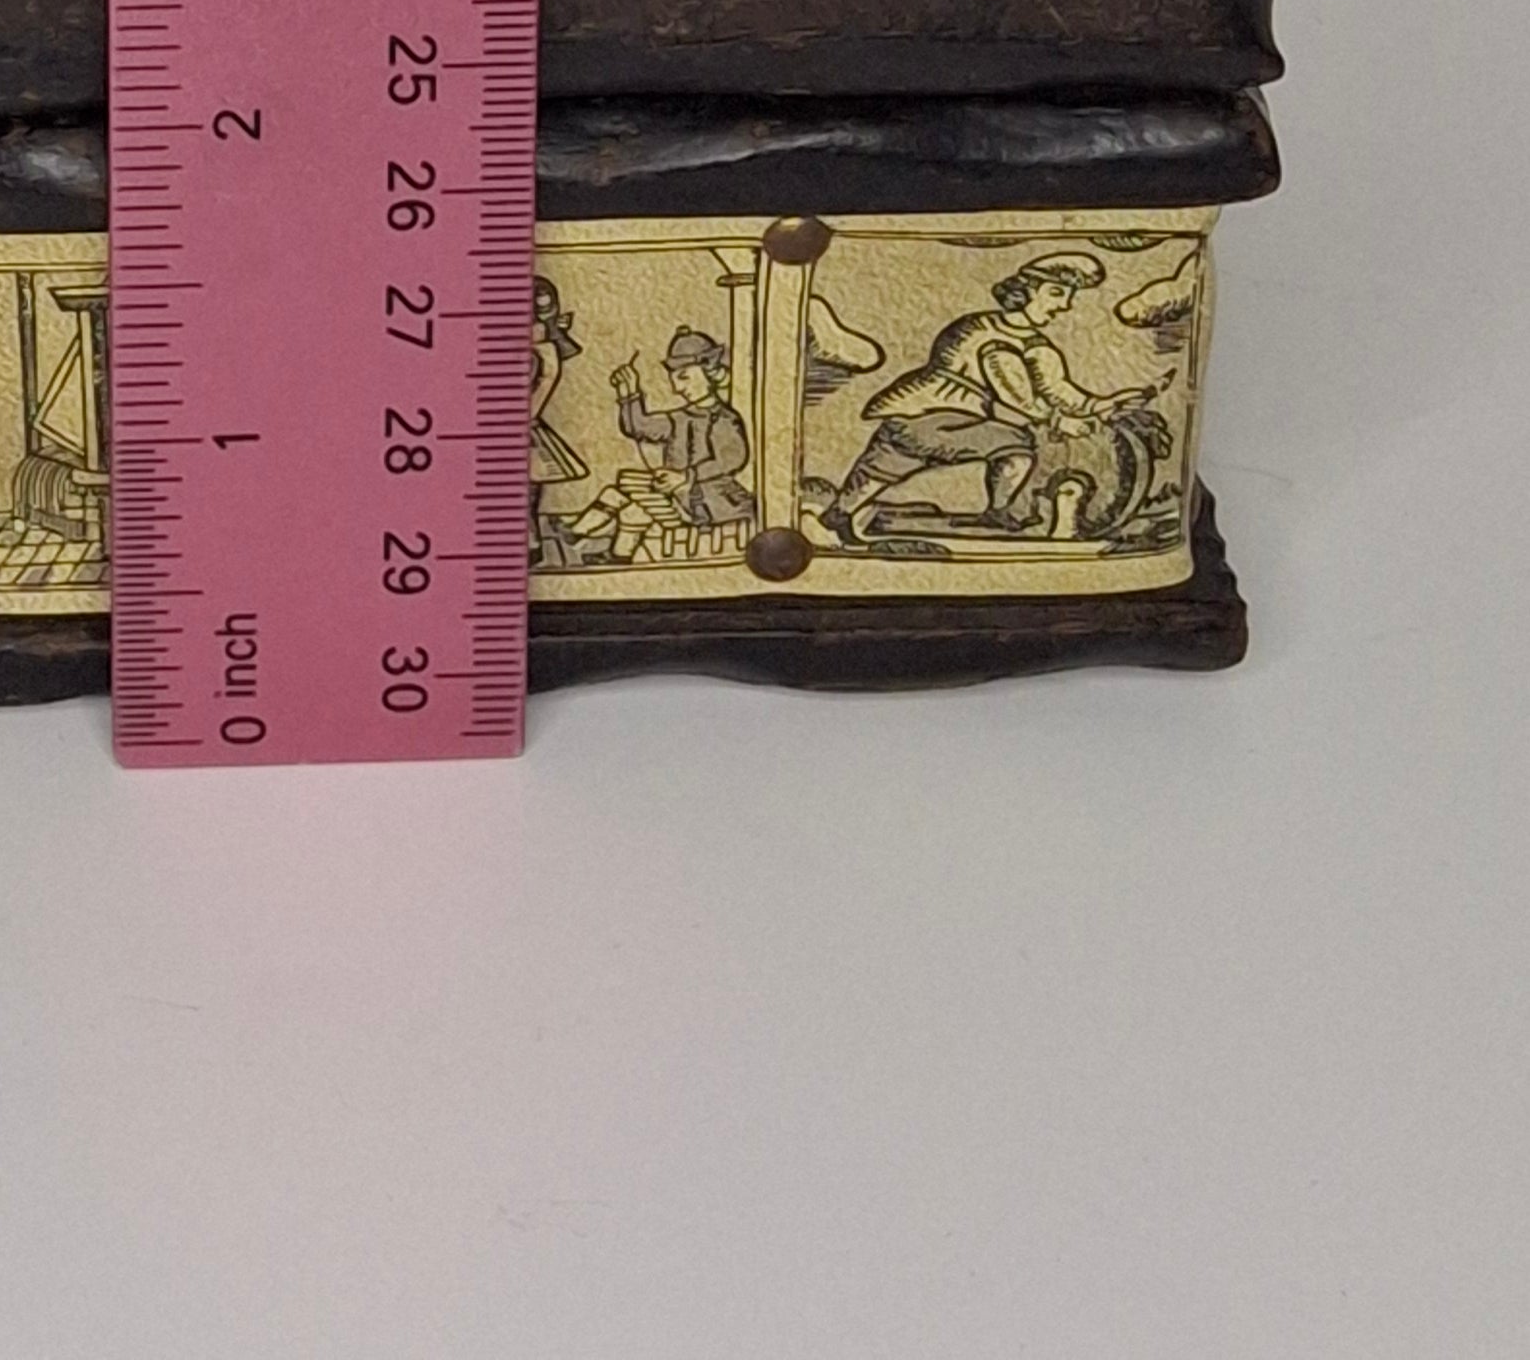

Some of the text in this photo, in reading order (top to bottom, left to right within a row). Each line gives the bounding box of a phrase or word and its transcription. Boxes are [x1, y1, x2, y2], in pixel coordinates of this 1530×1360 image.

[387, 34, 439, 106] 25
[211, 108, 262, 142] 2
[386, 159, 437, 232] 26
[385, 283, 436, 351] 27
[211, 433, 262, 451] 1
[383, 406, 434, 476] 28
[381, 530, 432, 596] 29
[212, 612, 268, 746] 0 inch
[380, 645, 430, 714] 30
